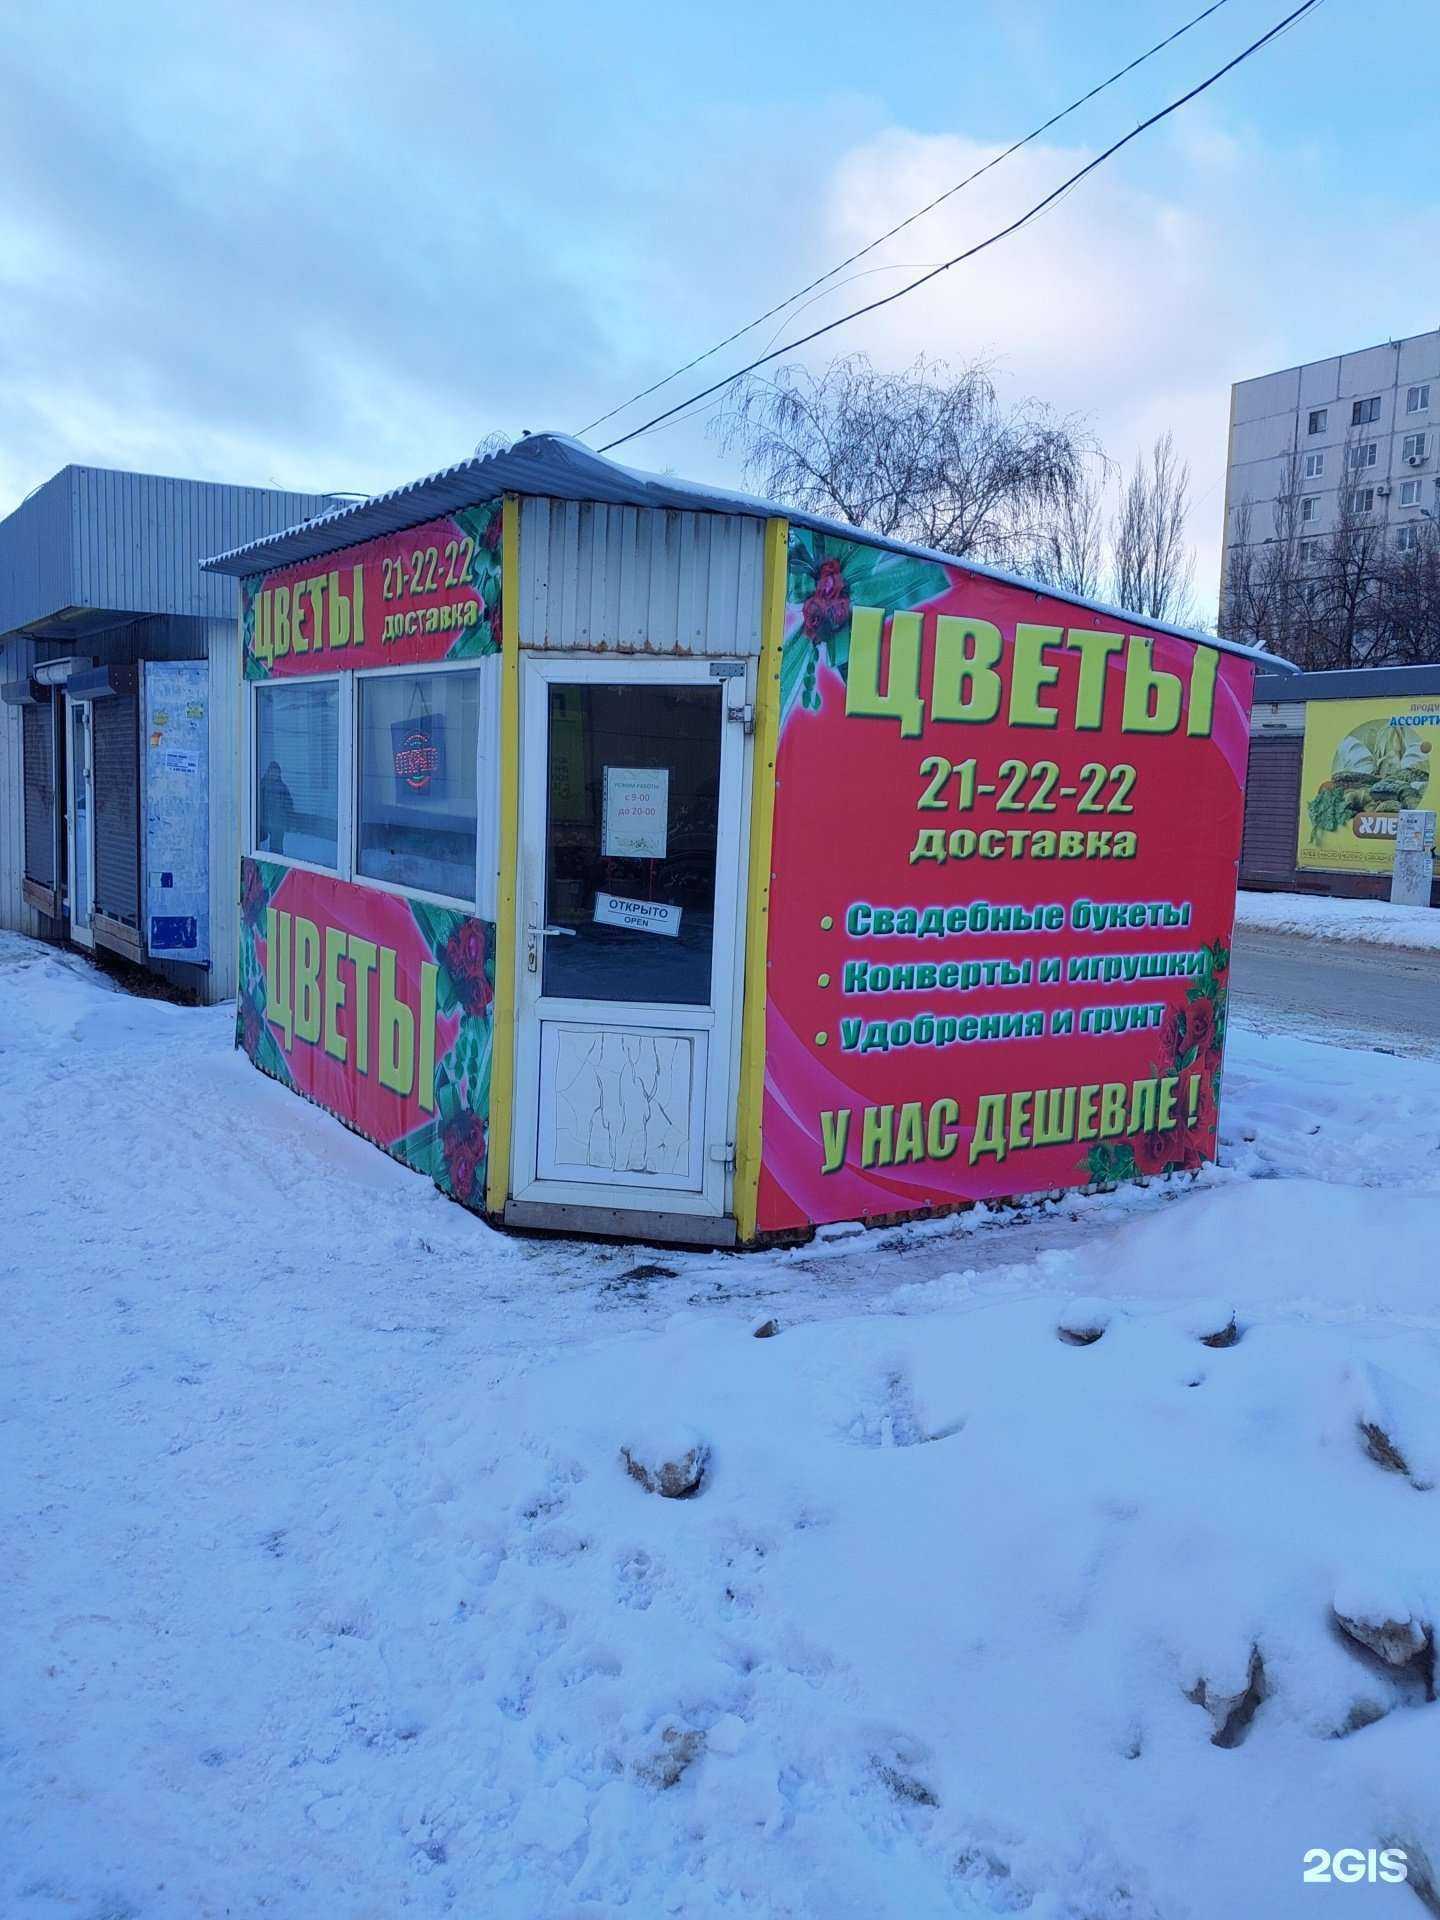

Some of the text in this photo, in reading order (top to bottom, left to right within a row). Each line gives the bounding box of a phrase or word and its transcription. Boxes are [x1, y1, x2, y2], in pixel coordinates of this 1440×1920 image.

[382, 536, 475, 601] 21-22-22
[254, 563, 365, 669] ЦВЕТЫ
[382, 598, 478, 642] доставка
[845, 605, 1220, 739] ЦВЕТЫ
[916, 755, 1137, 814] 21-22-22
[618, 807, 656, 817] до 20-00
[1359, 816, 1397, 835] ХЛЕ
[910, 828, 1137, 864] доставка
[609, 899, 669, 919] ОТКРЫТО
[624, 916, 649, 927] OPEN
[846, 899, 1191, 938] Свадебные букеты
[843, 950, 1206, 993] Конверты и игрушки
[266, 908, 438, 1114] ЦВЕТЫ
[840, 1002, 1165, 1053] Удобрения и грунт
[820, 1108, 851, 1174] У
[861, 1098, 960, 1169] НАС
